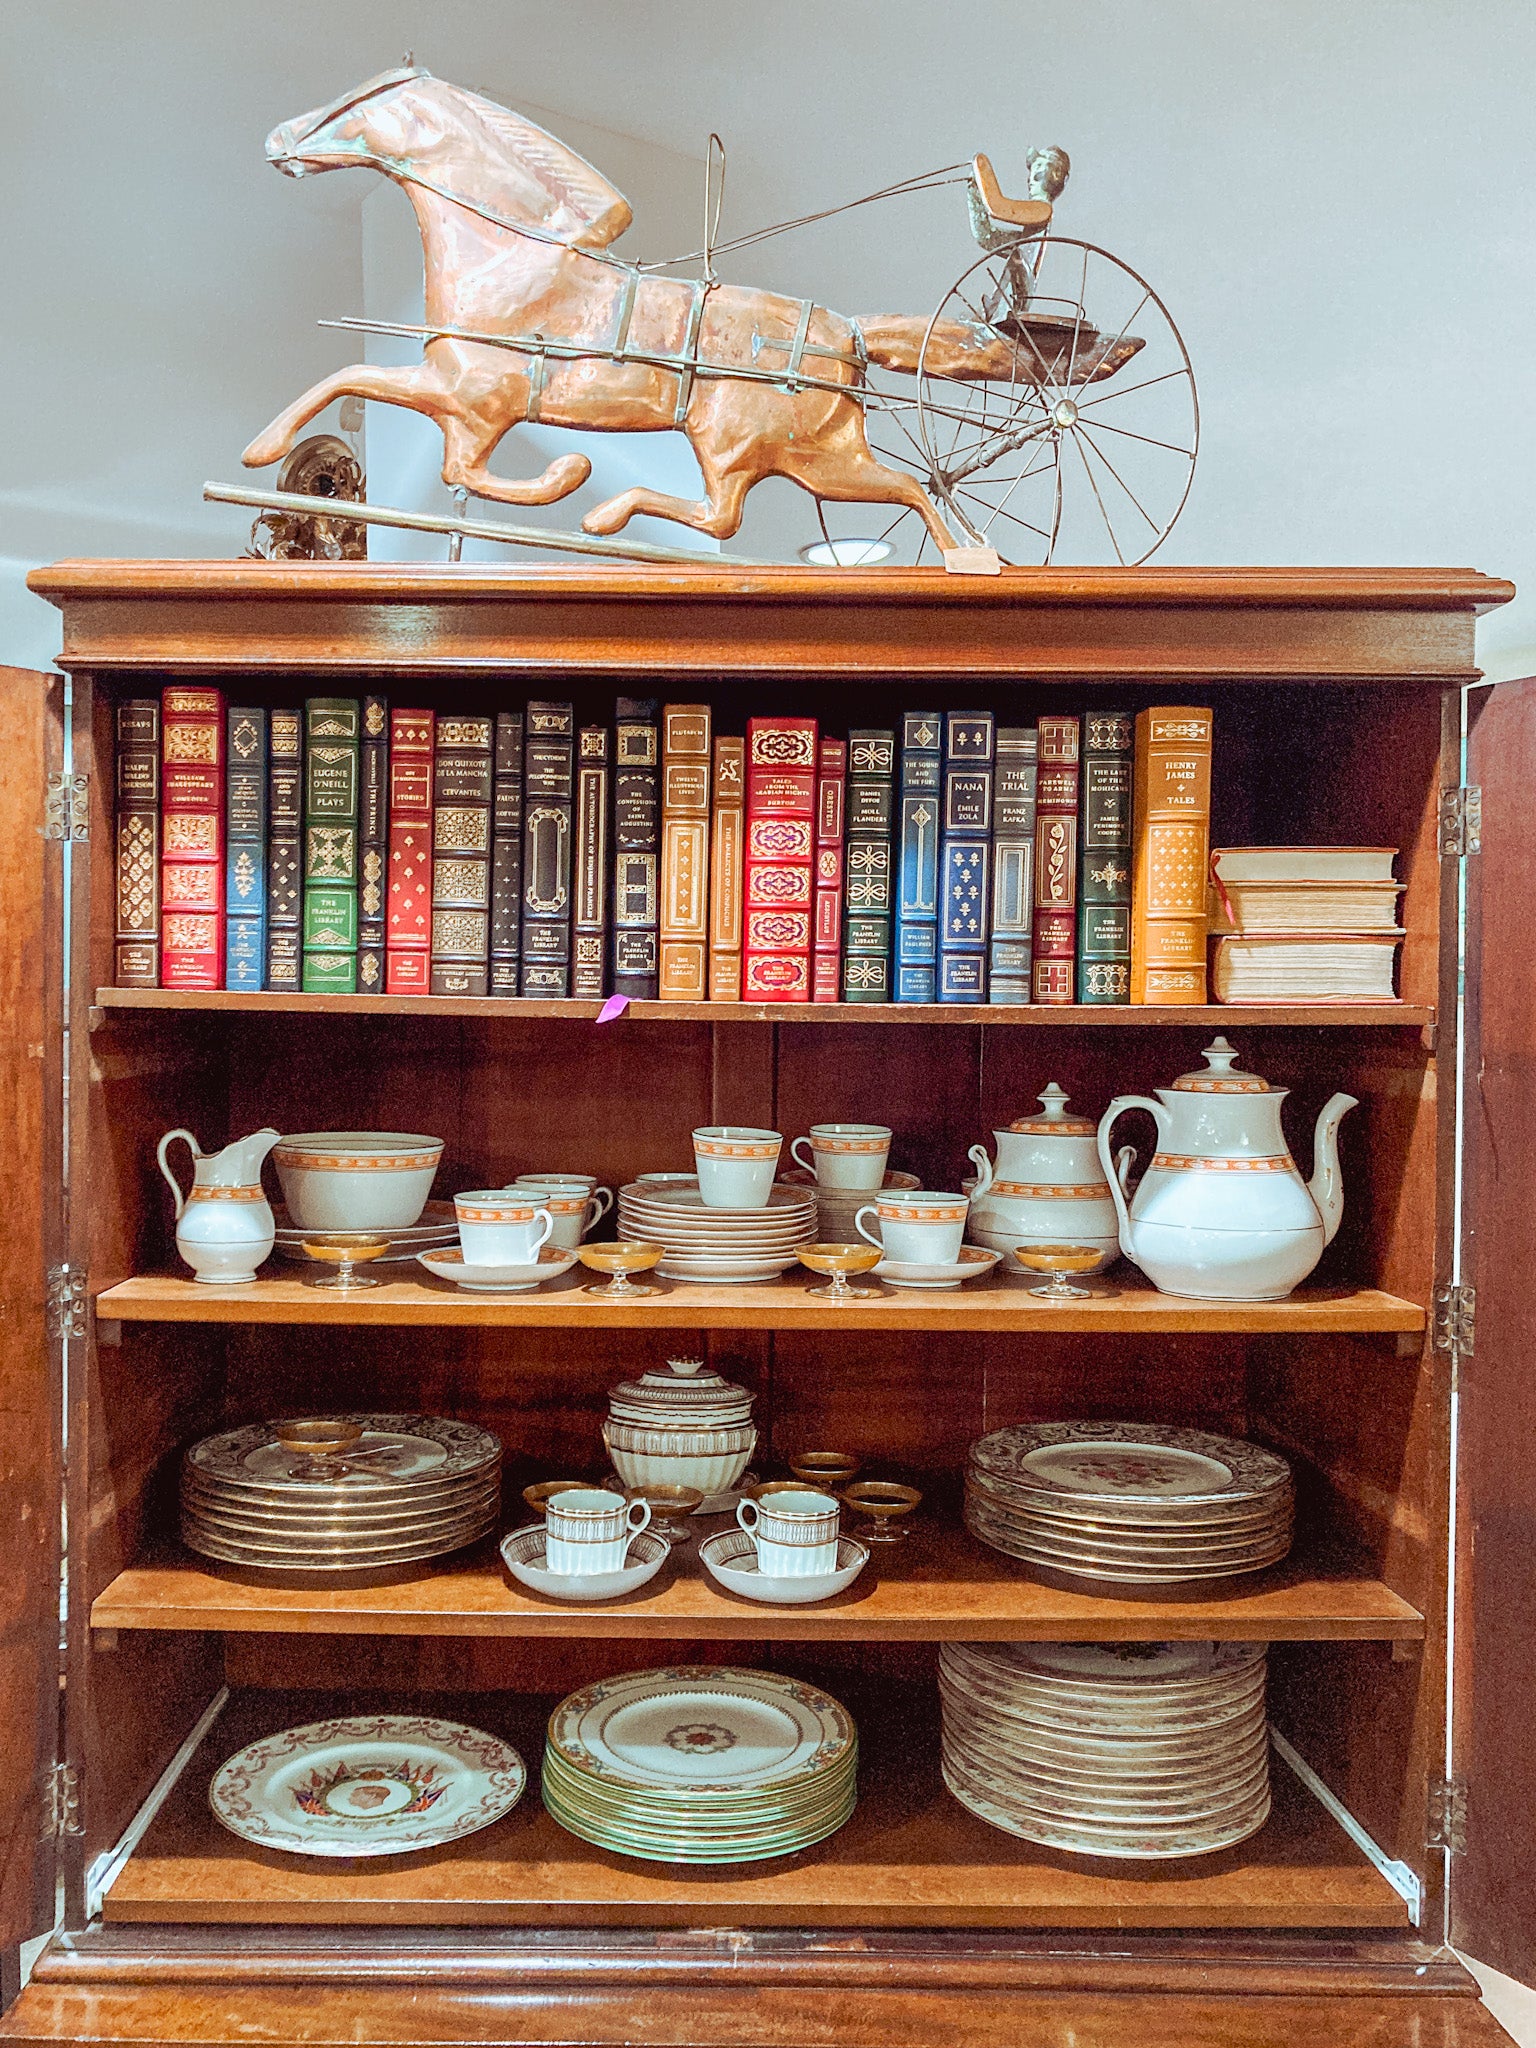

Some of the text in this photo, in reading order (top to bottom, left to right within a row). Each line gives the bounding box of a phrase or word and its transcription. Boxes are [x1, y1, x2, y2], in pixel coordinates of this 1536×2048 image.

[438, 760, 486, 768] DON QUIXOTE
[1165, 762, 1197, 770] HENRY
[313, 769, 348, 778] EUGENE
[1005, 772, 1026, 780] THE
[1165, 771, 1196, 780] JAMES
[313, 780, 348, 789] O'NEILL
[954, 783, 984, 791] NANA
[1001, 782, 1029, 791] TRIAL
[442, 788, 481, 797] CERVANTES
[316, 798, 344, 807] PLAYS
[1166, 796, 1195, 805] TALES
[957, 804, 980, 812] ÉMILE
